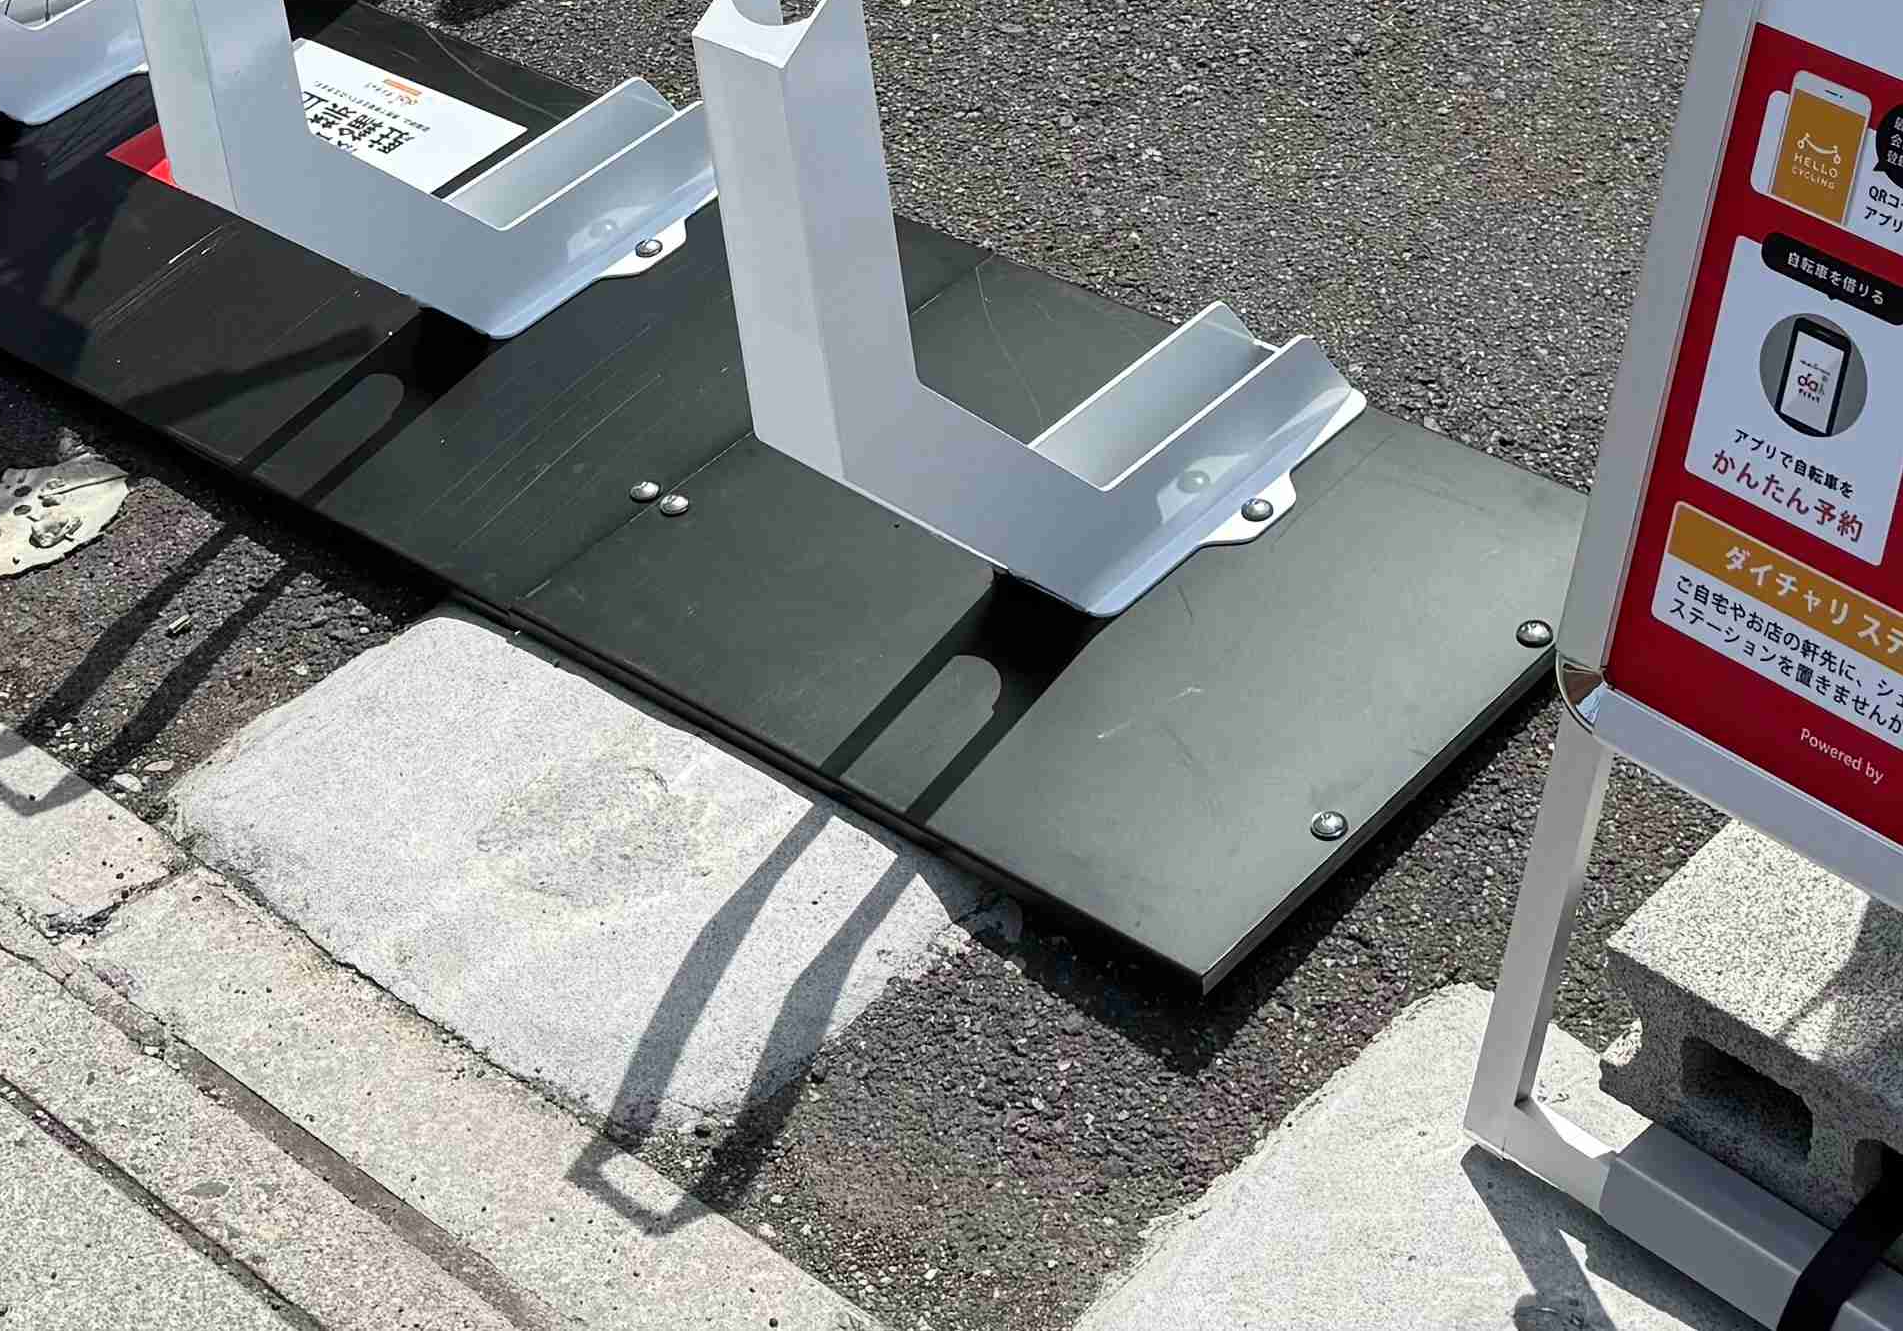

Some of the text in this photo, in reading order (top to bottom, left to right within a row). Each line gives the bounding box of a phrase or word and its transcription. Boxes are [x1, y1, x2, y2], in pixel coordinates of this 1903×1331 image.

[1791, 167, 1836, 190] CYCLING
[1793, 152, 1839, 178] HELLO
[1786, 251, 1884, 306] 自転車を借りる
[1733, 428, 1853, 499] アプリで自転車を
[1712, 450, 1863, 543] かんたん予約
[1800, 728, 1885, 785] Powered by
